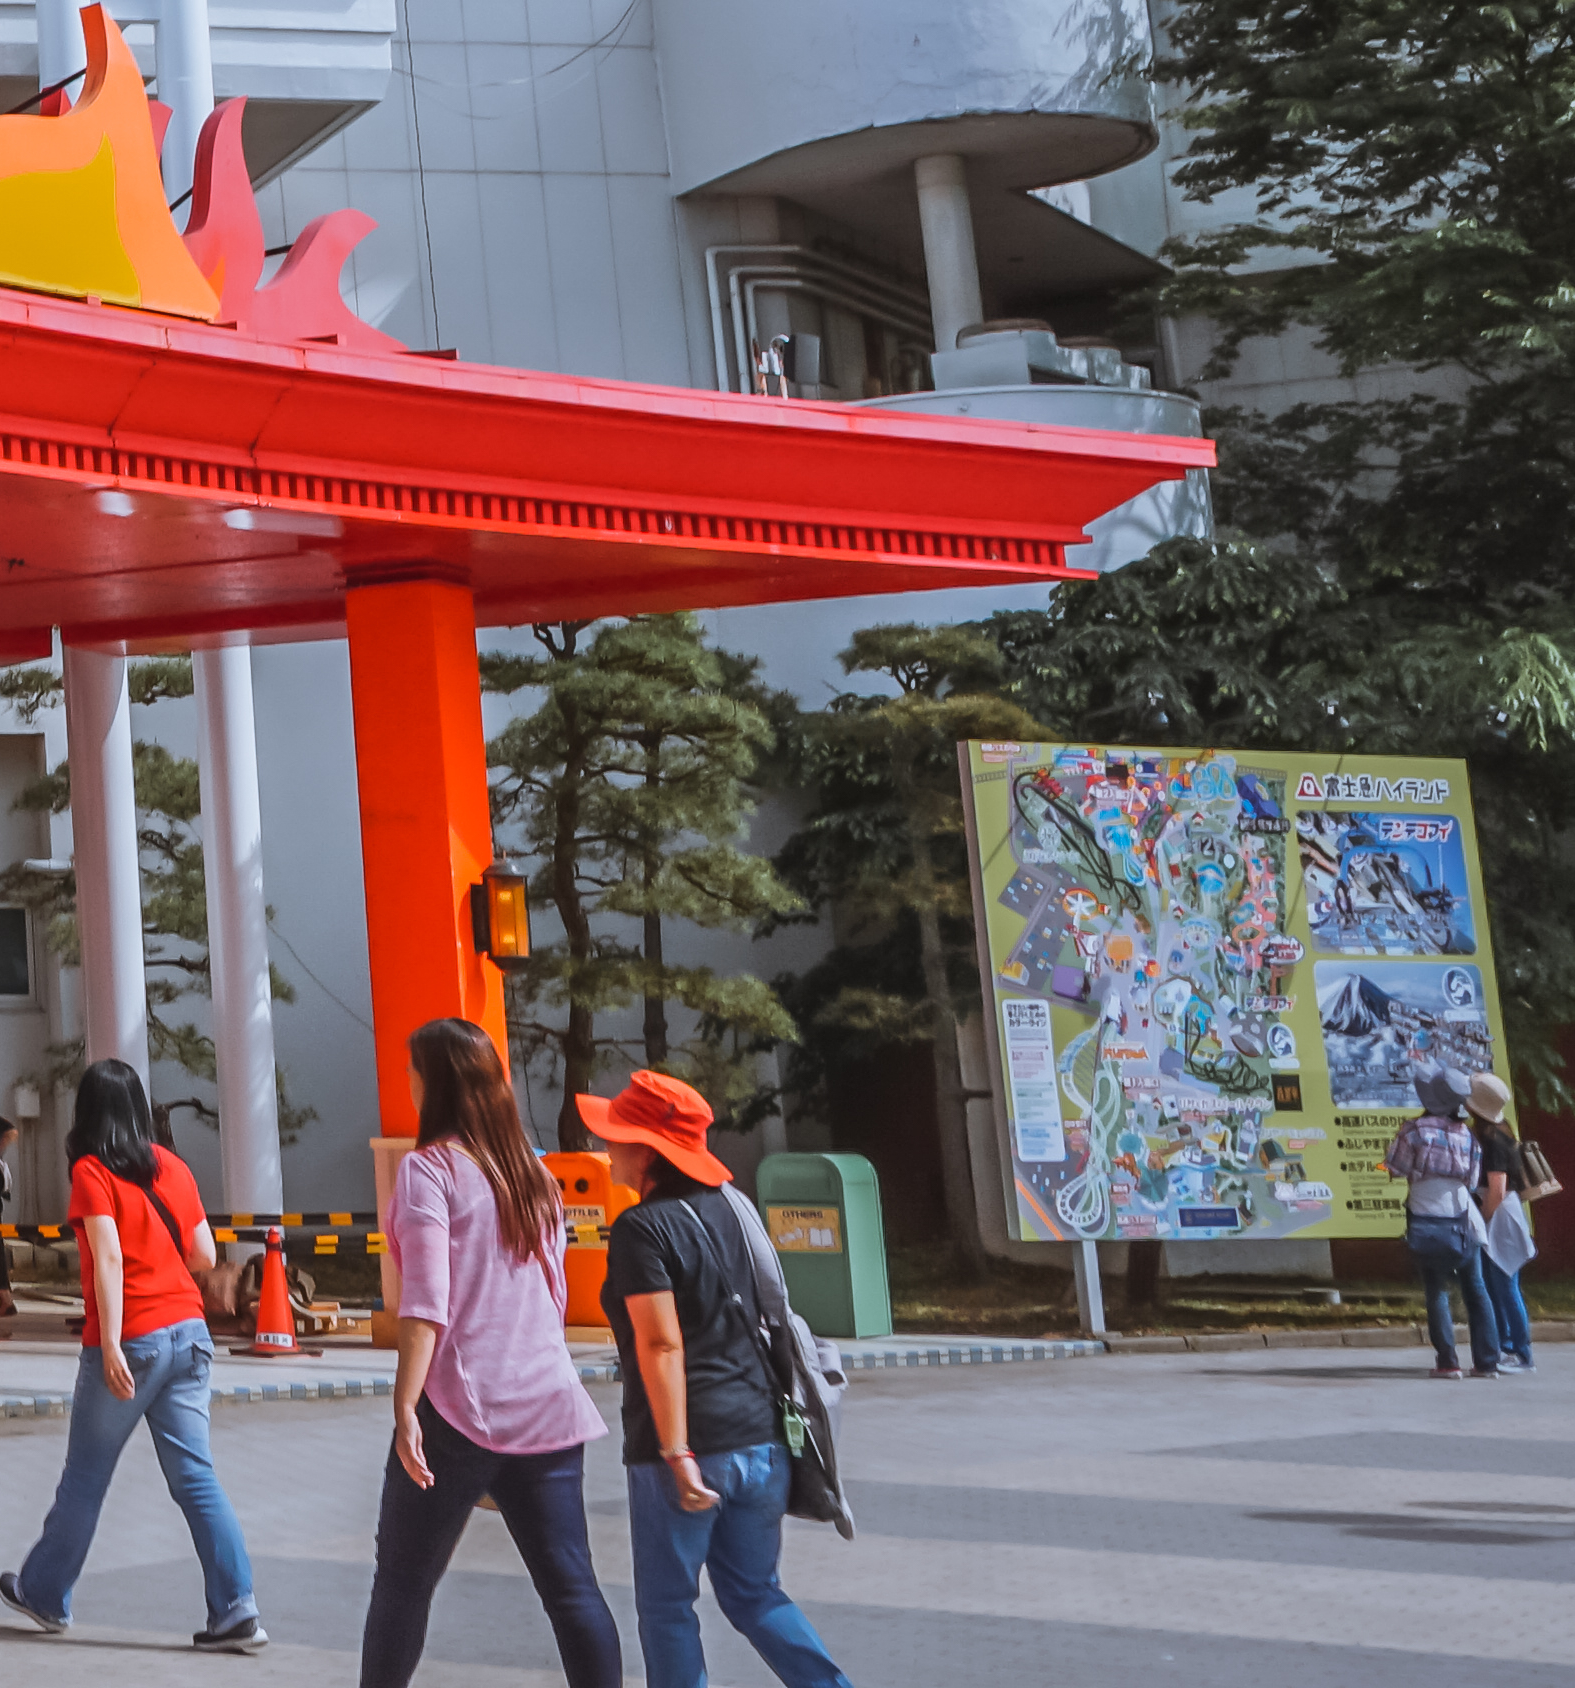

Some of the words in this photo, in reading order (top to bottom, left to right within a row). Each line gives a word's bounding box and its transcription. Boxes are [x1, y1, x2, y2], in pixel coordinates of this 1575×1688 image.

[1324, 775, 1447, 801] 富士急ハイランド
[782, 1210, 823, 1219] OTHERS
